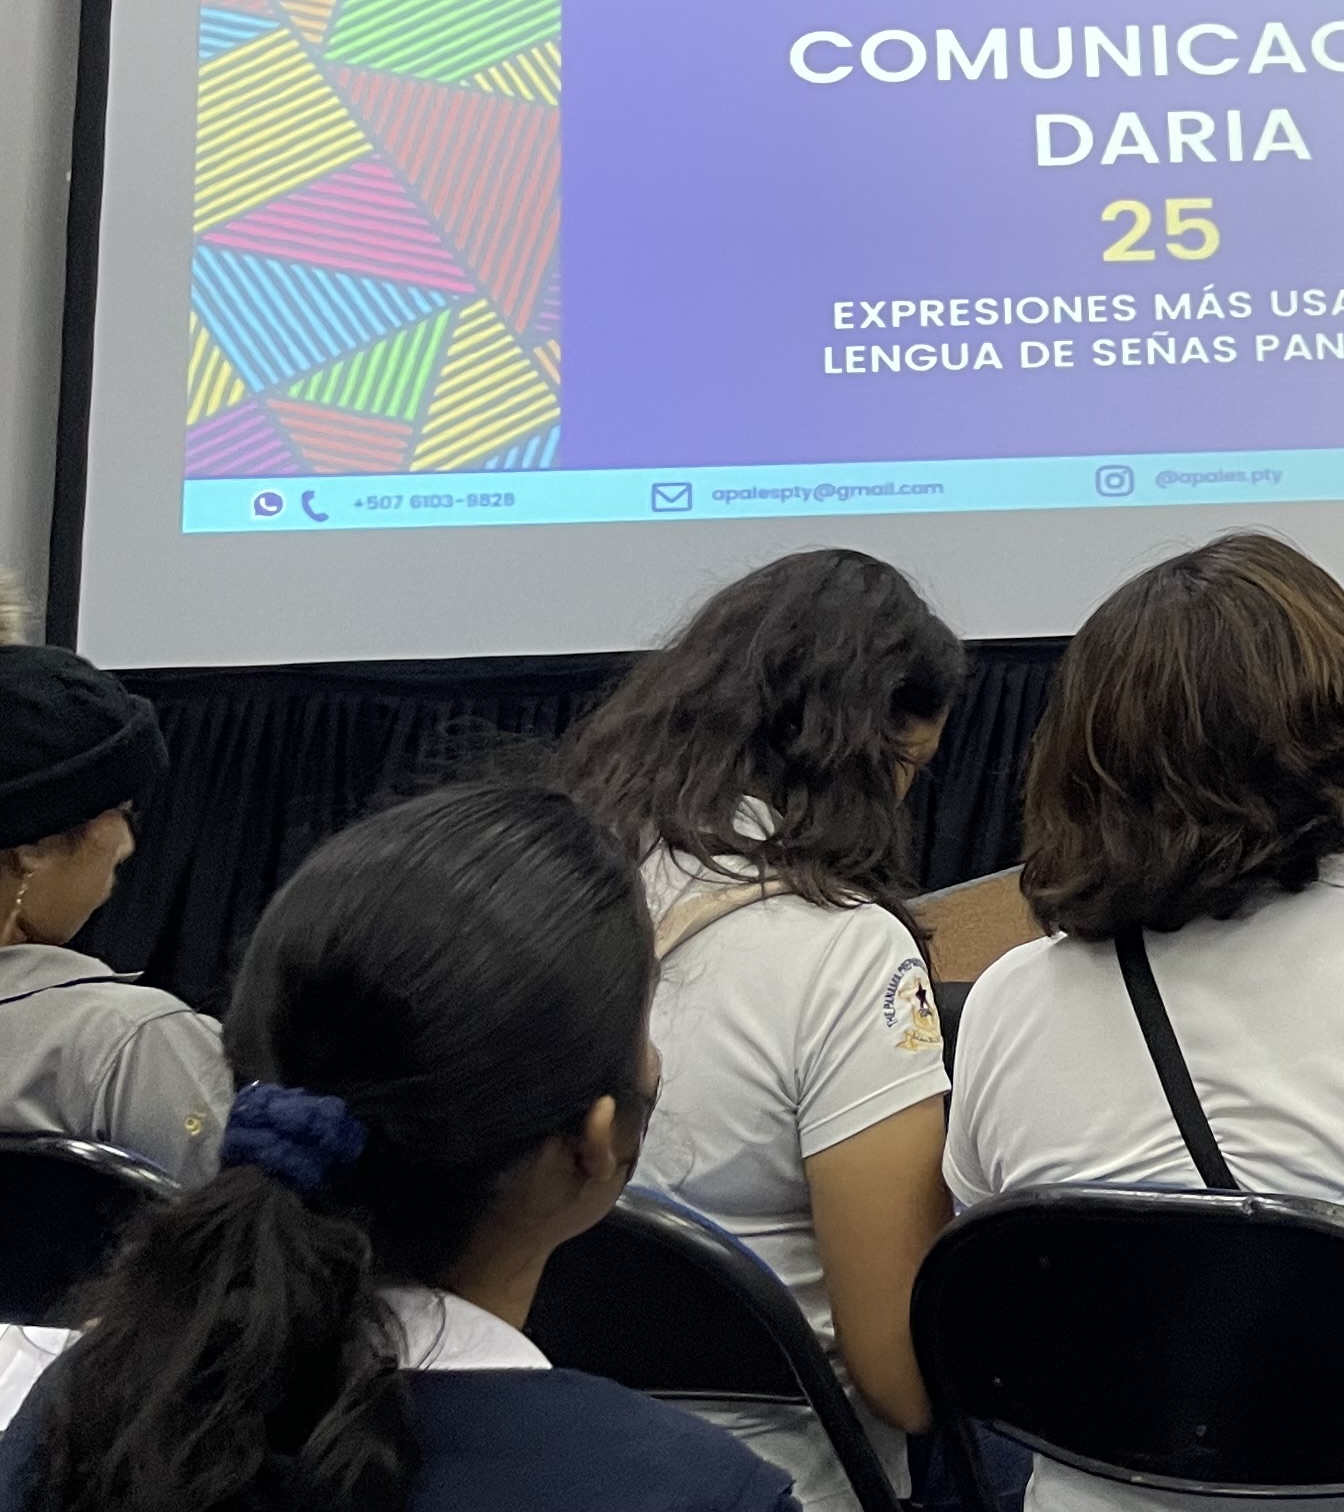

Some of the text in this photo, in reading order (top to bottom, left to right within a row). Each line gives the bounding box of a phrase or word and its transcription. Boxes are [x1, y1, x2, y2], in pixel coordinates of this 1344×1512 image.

[1035, 108, 1312, 168] DARIA
[1101, 197, 1221, 263] 25
[833, 294, 1137, 329] EXPRESIONES
[1153, 284, 1252, 322] MÁS
[823, 342, 1003, 374] LENGUA
[1021, 338, 1074, 368] DE
[1092, 329, 1237, 366] SEÑAS
